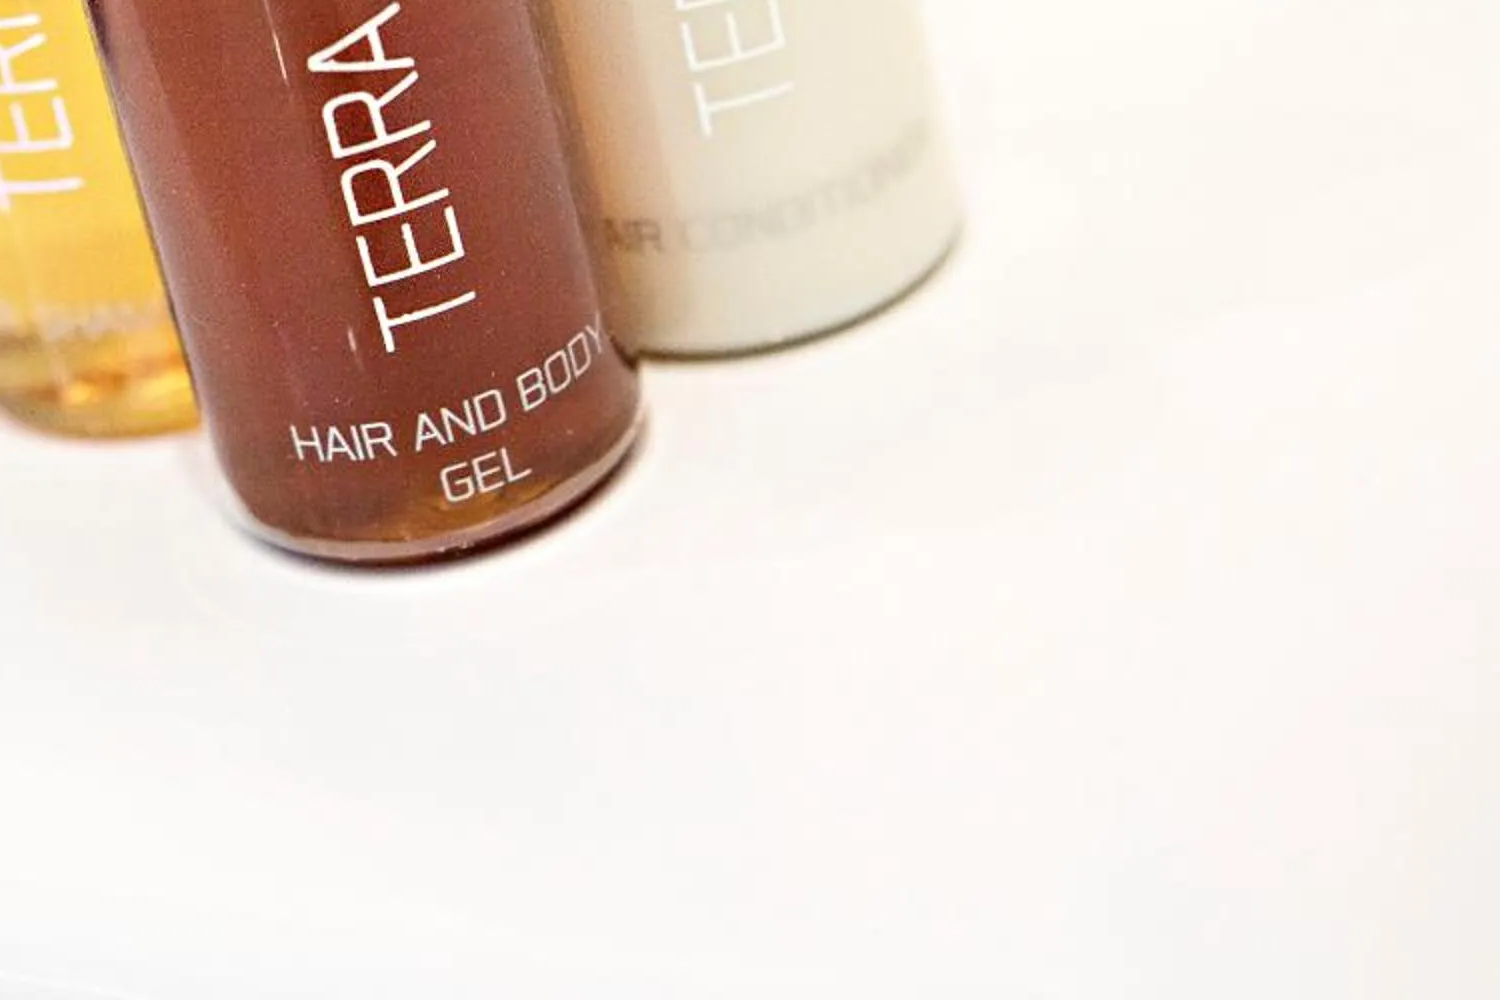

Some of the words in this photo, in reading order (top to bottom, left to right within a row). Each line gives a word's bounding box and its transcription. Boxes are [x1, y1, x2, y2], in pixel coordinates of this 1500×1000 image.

[306, 1, 477, 353] TERRA
[598, 215, 665, 253] AIR
[289, 421, 398, 463] HAIR
[414, 388, 507, 452] AND
[516, 310, 602, 412] BODY
[438, 446, 533, 504] GEL
